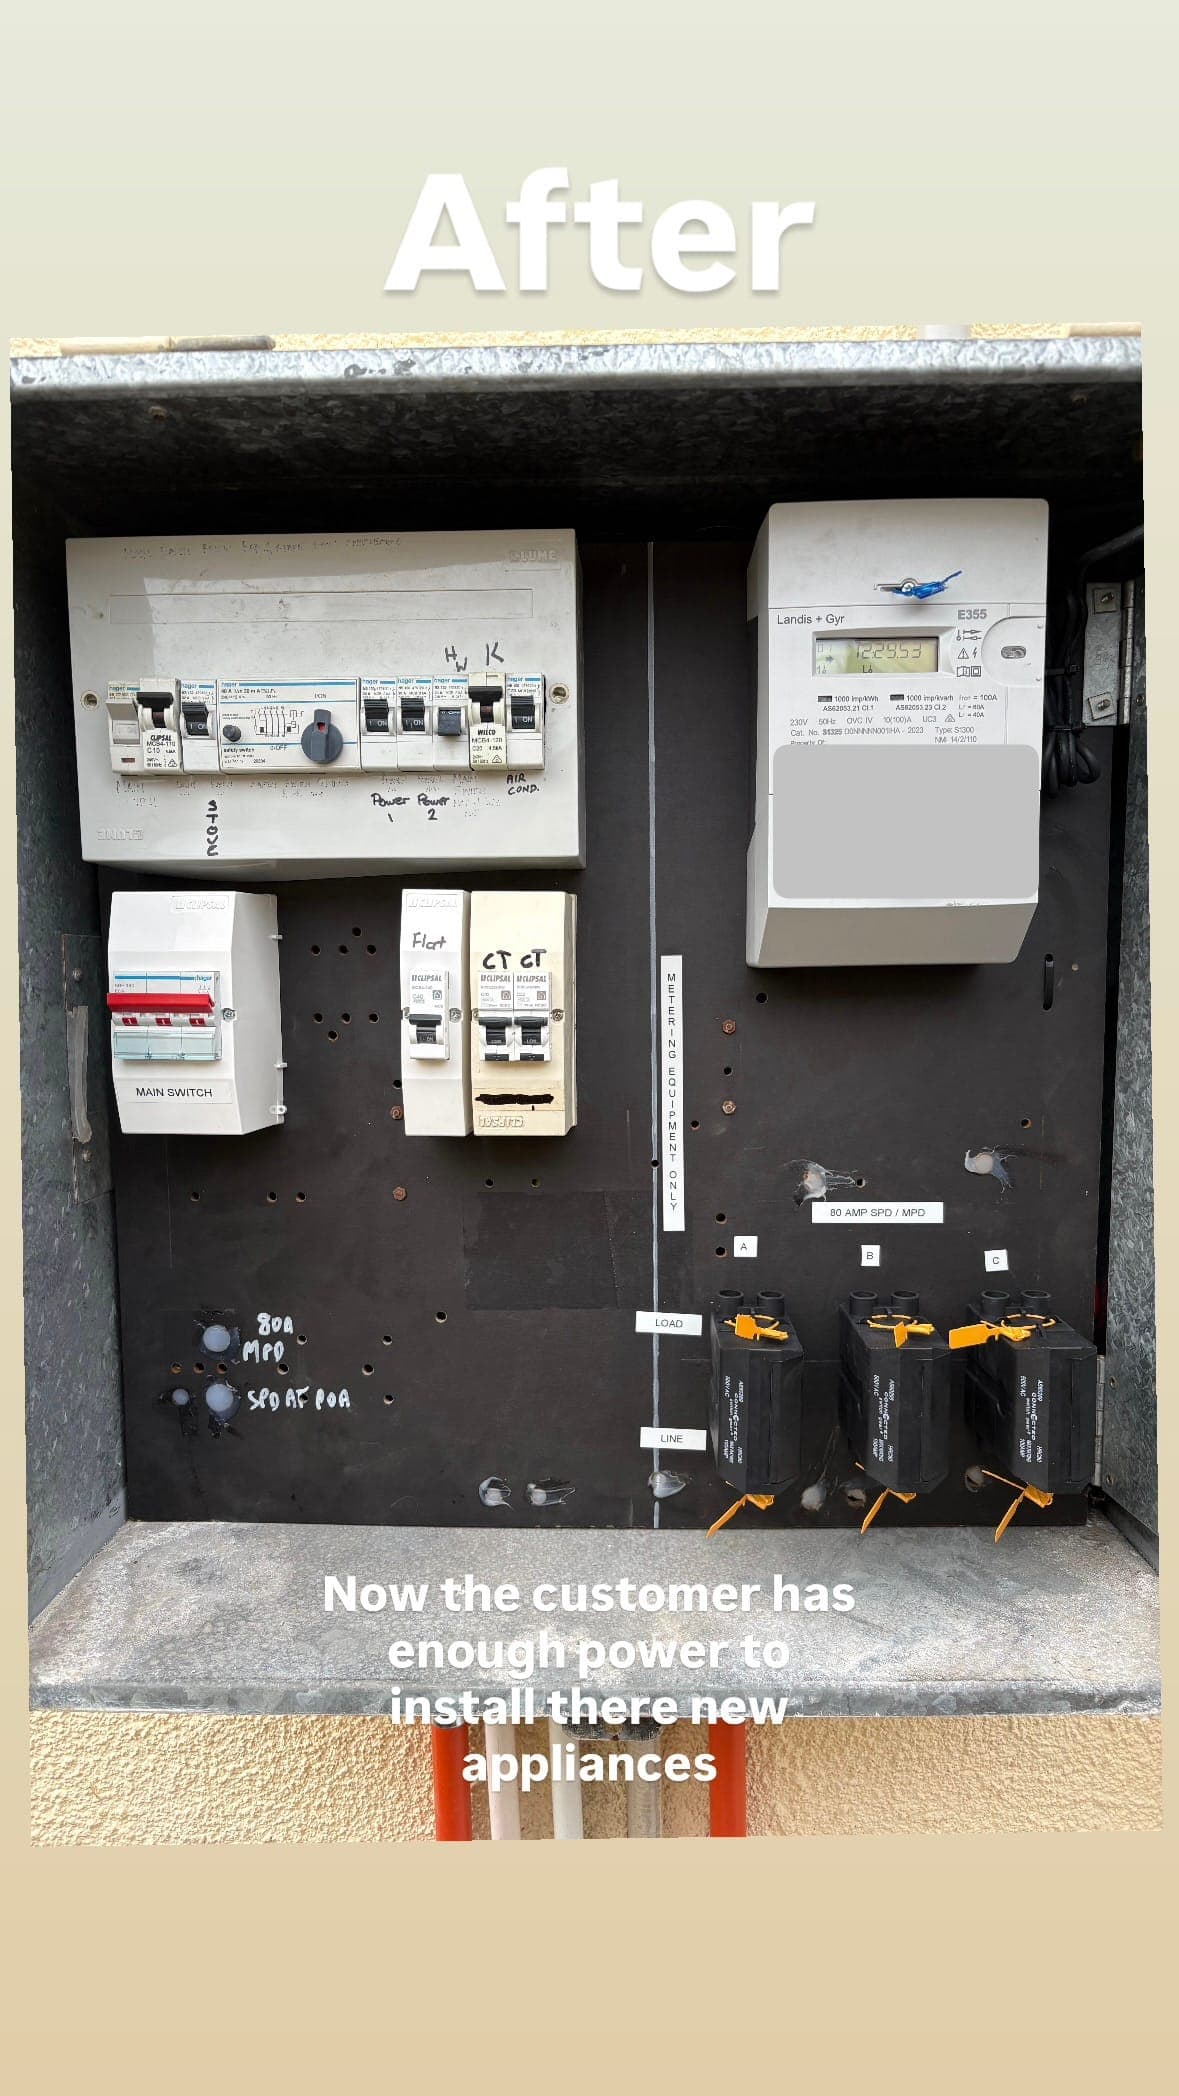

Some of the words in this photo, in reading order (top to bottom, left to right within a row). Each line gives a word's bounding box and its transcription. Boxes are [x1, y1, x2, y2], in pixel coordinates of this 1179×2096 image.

[777, 614, 812, 625] Landis
[815, 615, 823, 623] +
[825, 613, 845, 626] Gyr
[957, 609, 987, 620] E355
[486, 641, 504, 666] K
[851, 695, 879, 704] imp/kWh
[790, 718, 809, 726] 230V
[790, 729, 805, 737] Cat.
[507, 773, 526, 784] AIR
[428, 809, 438, 820] 2
[412, 931, 447, 950] Flat
[482, 949, 512, 970] CT
[520, 949, 547, 968] CT
[418, 974, 442, 982] CLIPSAL
[667, 973, 677, 1059] METERING
[136, 1087, 164, 1097] MAIN
[167, 1087, 213, 1098] SWITCH
[668, 1067, 677, 1162] EQUIPMENT
[669, 1170, 678, 1211] ONLY
[830, 1207, 842, 1218] 80
[845, 1207, 868, 1218] AMP
[870, 1207, 894, 1218] SPD
[902, 1207, 926, 1218] MPD
[740, 1243, 748, 1251] A
[866, 1252, 874, 1260] B
[992, 1257, 1001, 1265] C
[256, 1312, 293, 1336] 80A
[655, 1318, 683, 1329] LOAD
[242, 1339, 285, 1363] MPD
[660, 1434, 683, 1443] LINE
